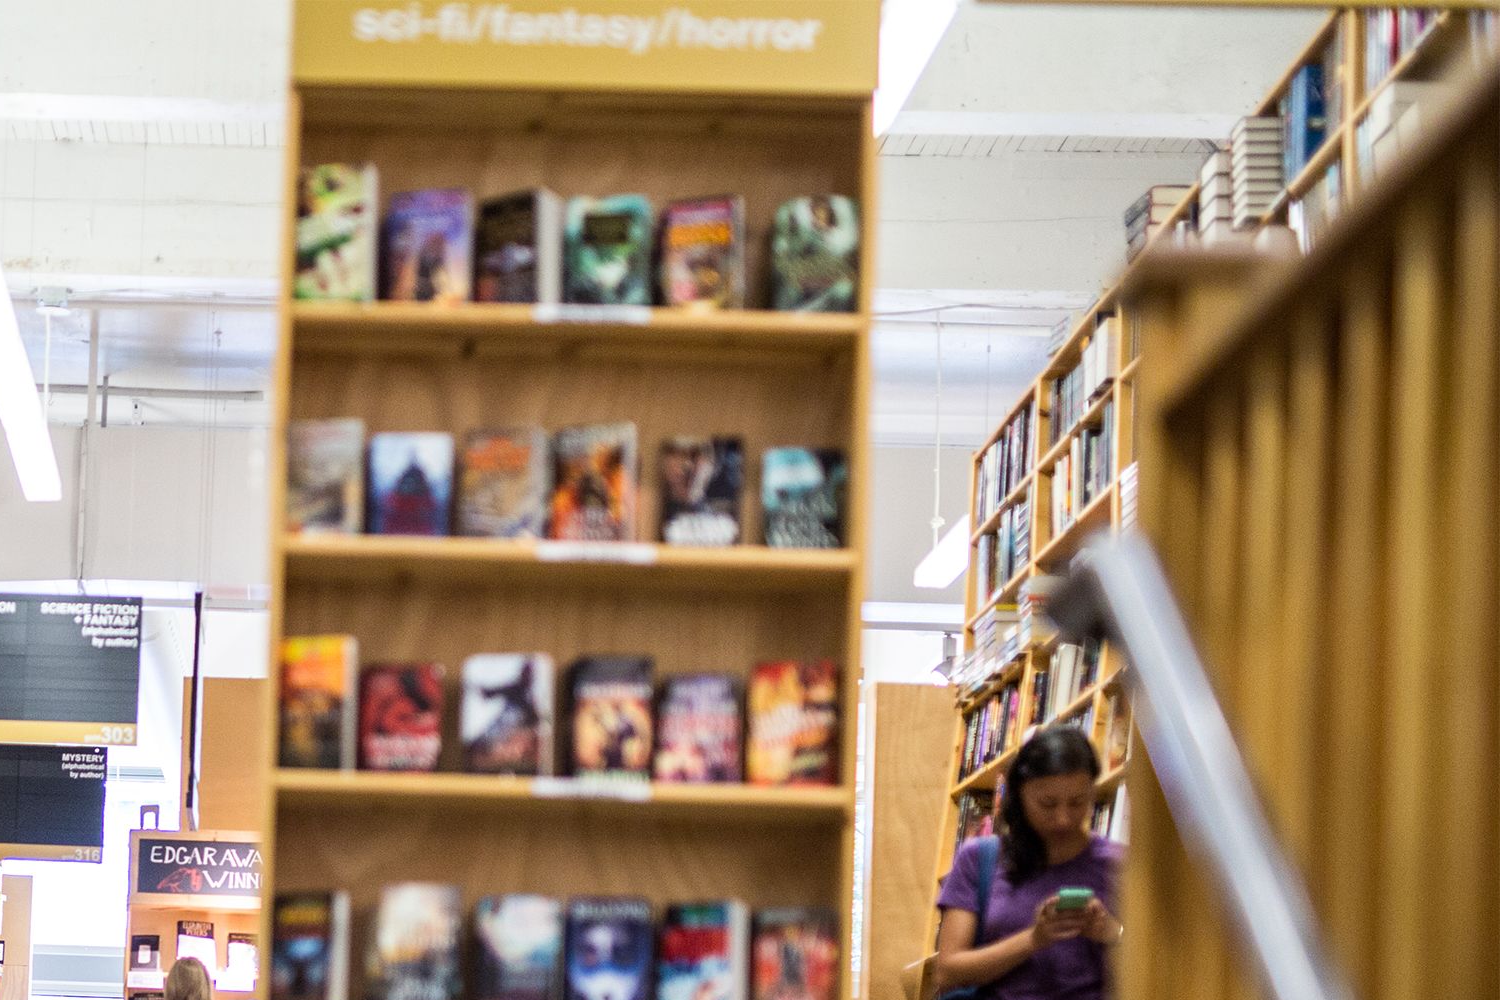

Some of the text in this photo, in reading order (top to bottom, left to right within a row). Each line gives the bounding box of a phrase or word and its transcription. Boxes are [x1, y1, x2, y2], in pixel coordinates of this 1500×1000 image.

[40, 602, 139, 616] SCIENCE FICTION
[83, 614, 137, 627] FANTASY
[100, 726, 133, 743] 303
[62, 753, 104, 763] MYSTERY
[62, 762, 104, 771] (alphabetical
[69, 771, 104, 780] by author)
[74, 848, 100, 861] 316
[150, 846, 218, 866] EDGAR
[203, 870, 264, 890] WINN
